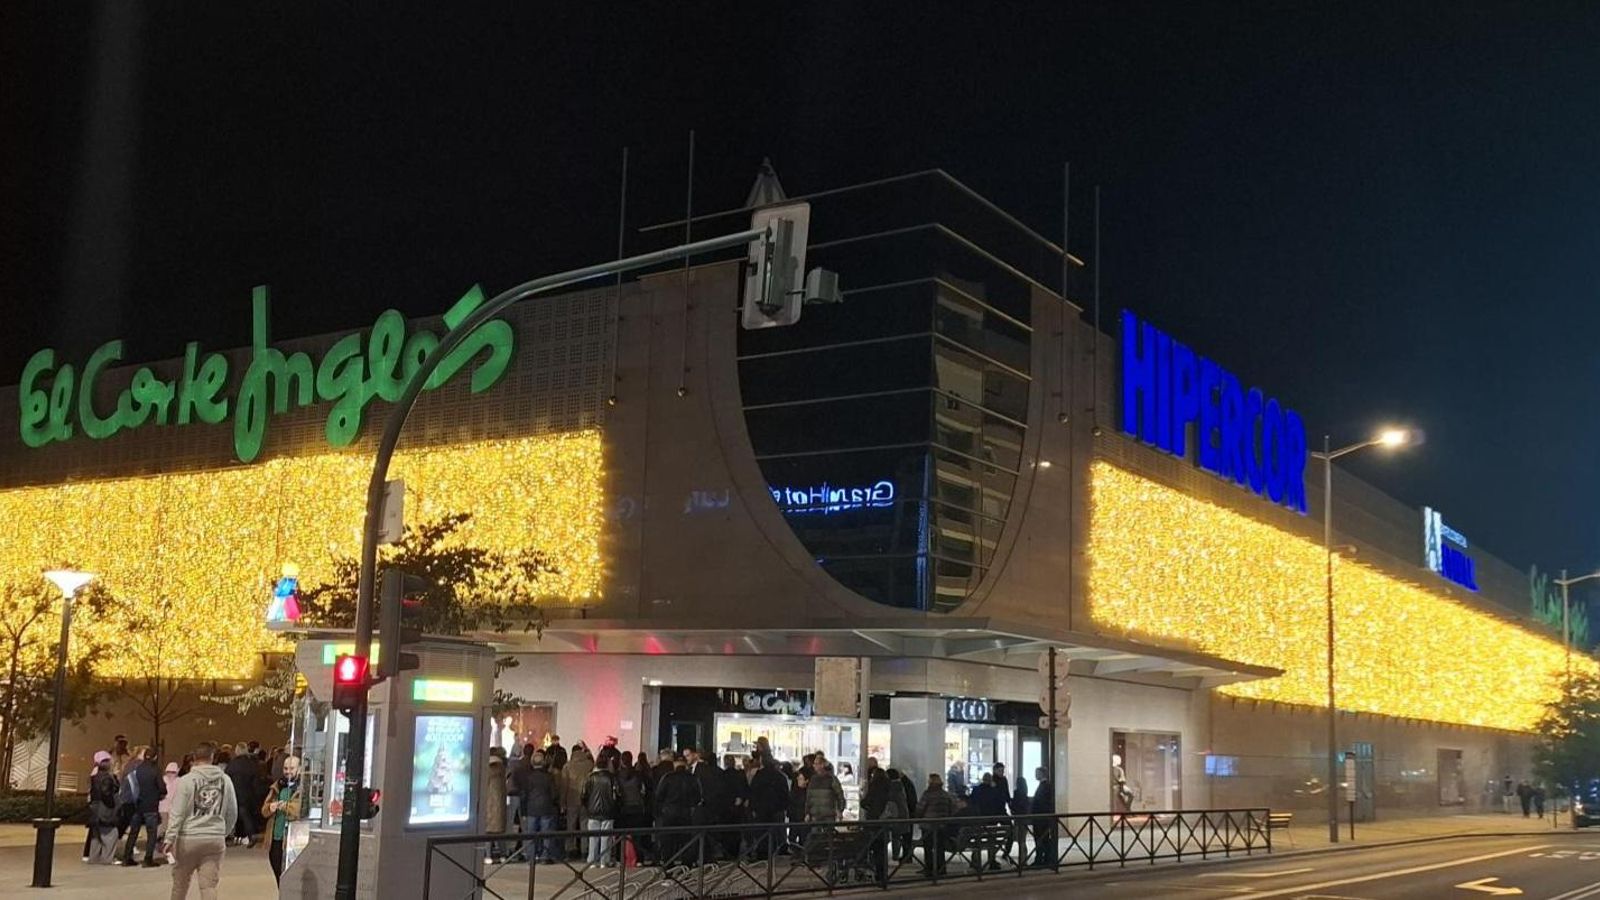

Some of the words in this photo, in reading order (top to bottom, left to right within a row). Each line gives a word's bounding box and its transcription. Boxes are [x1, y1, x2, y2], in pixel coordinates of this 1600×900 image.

[19, 347, 75, 448] El
[78, 339, 229, 440] Corte
[233, 283, 516, 464] Inglés
[1121, 308, 1308, 515] HIPERCOR
